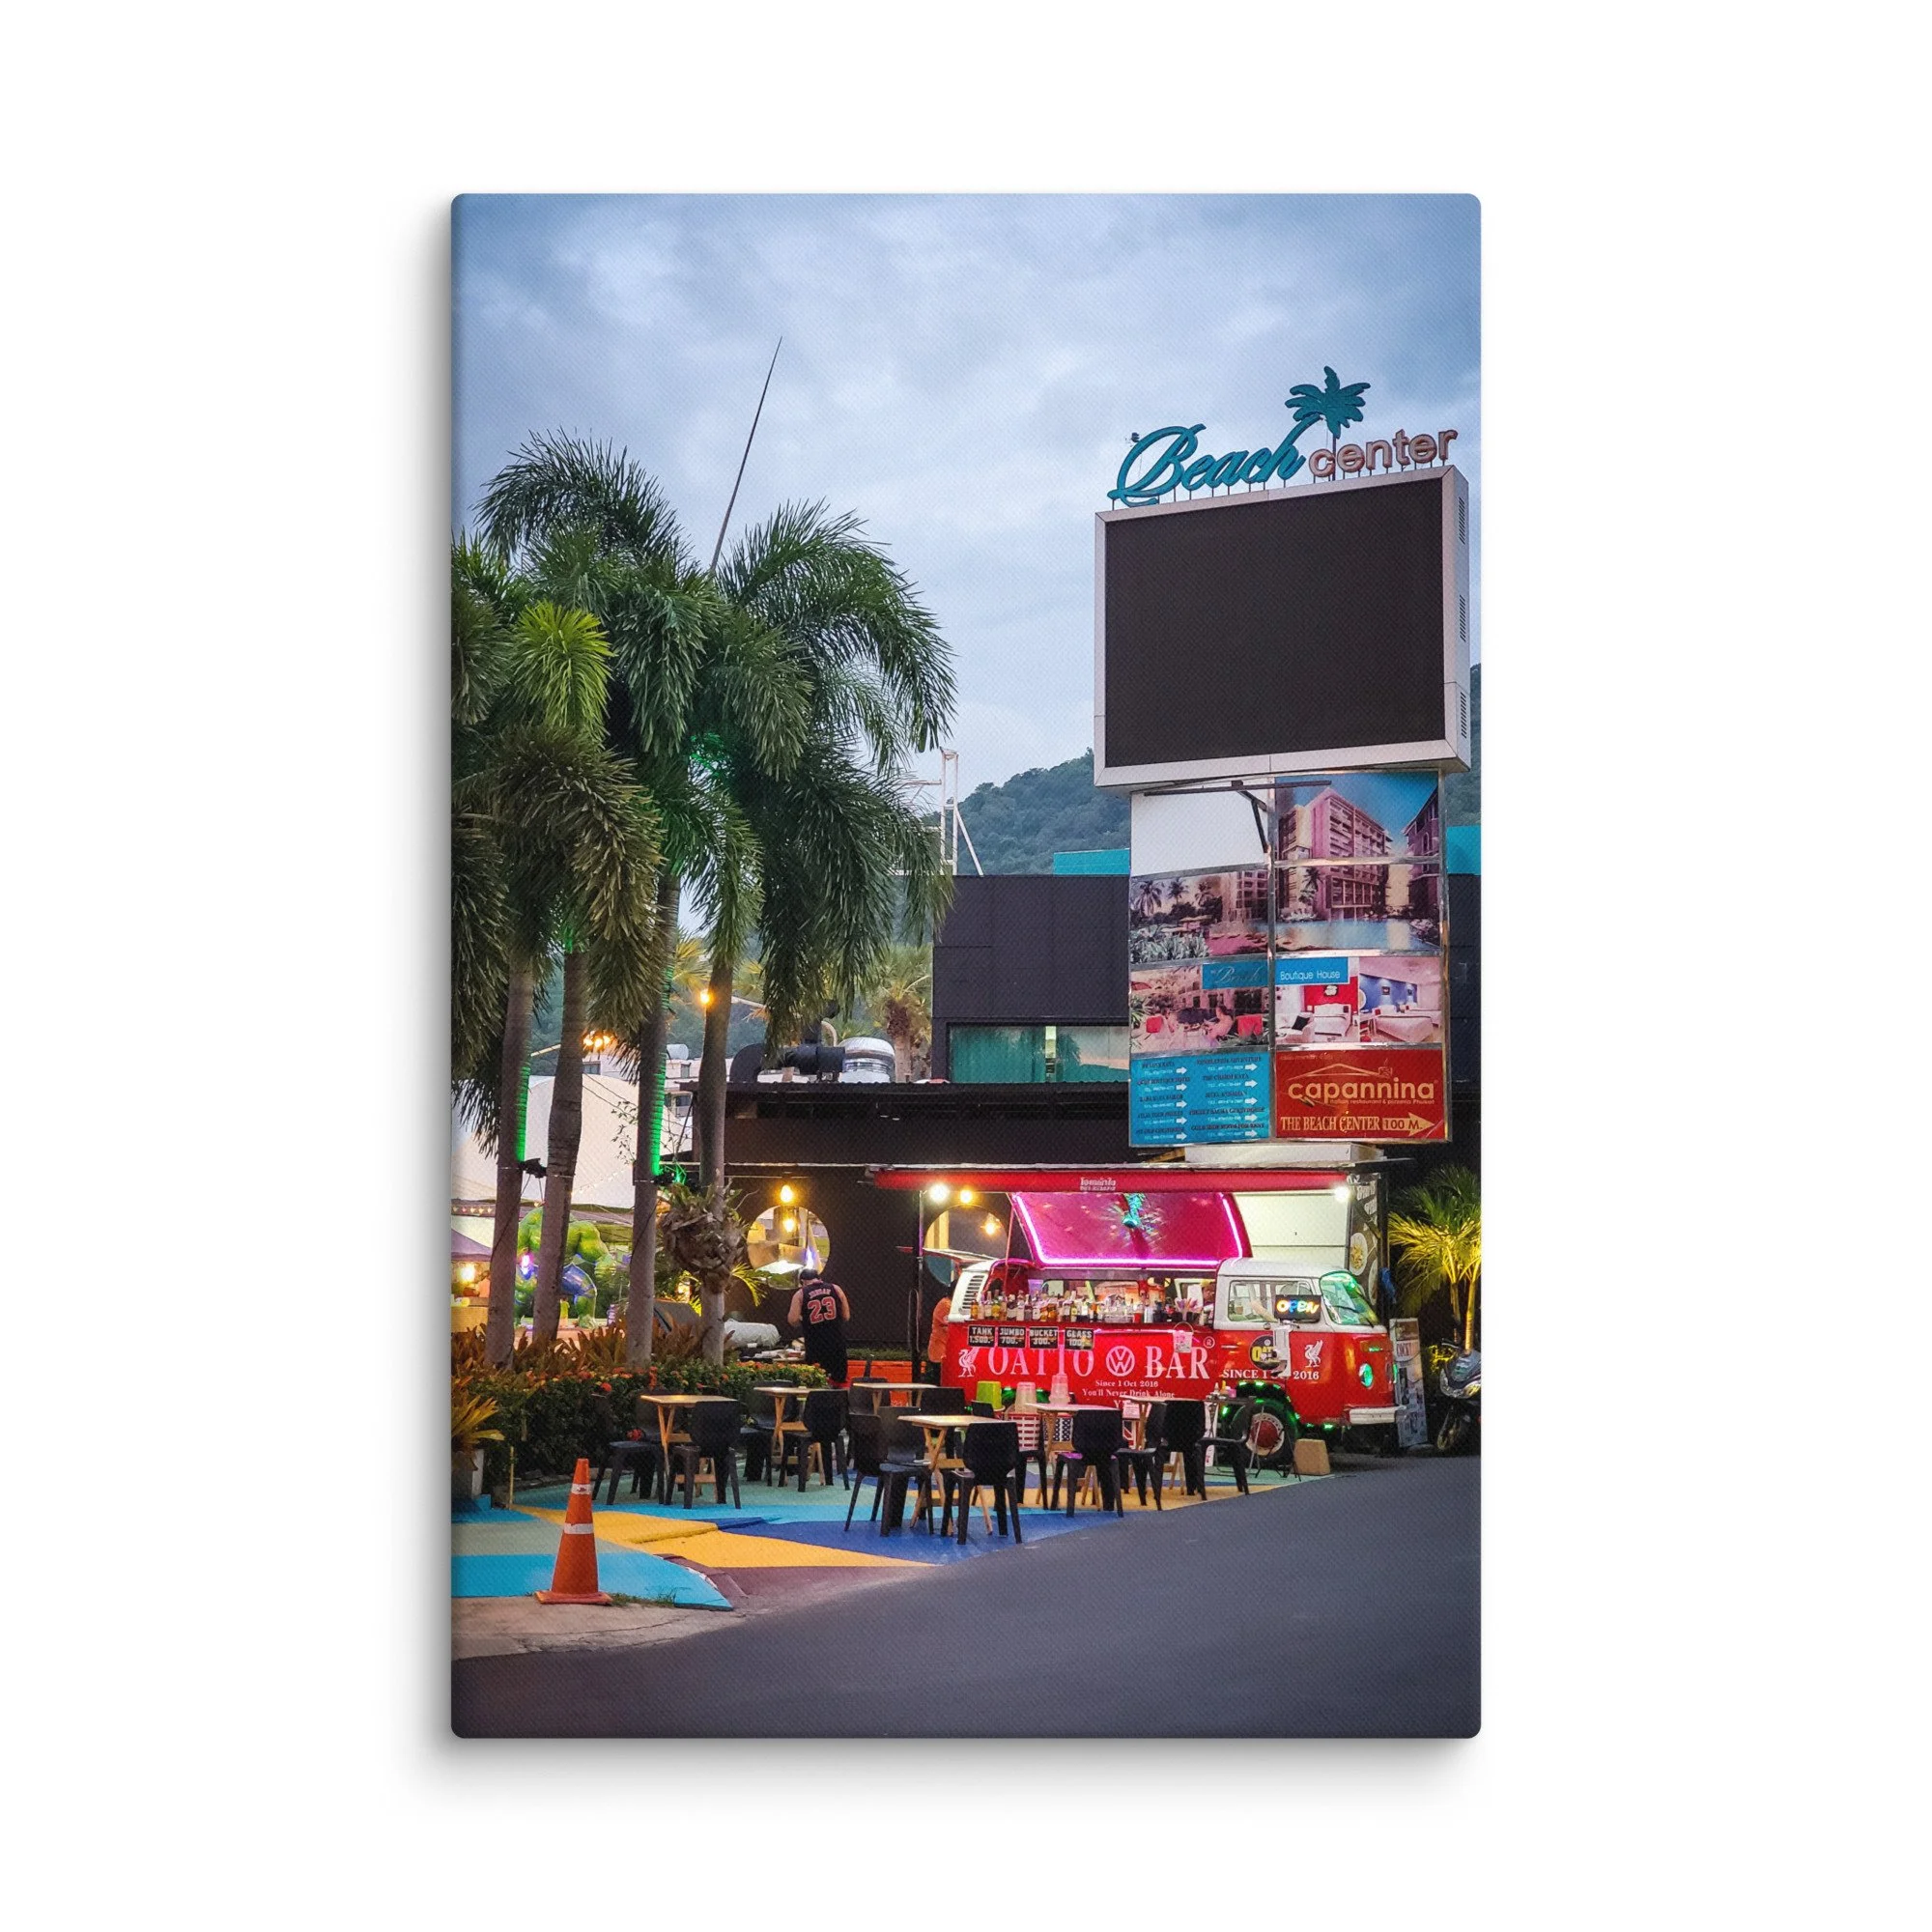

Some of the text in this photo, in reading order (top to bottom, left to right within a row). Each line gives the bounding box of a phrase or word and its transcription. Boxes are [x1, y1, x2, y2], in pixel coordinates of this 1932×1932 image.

[1107, 411, 1459, 508] Beach center
[1280, 971, 1341, 980] Boutique House
[1288, 1076, 1435, 1104] capannina
[1281, 1116, 1301, 1131] THE
[1304, 1116, 1337, 1131] BEACH
[1339, 1116, 1380, 1132] CENTER
[1384, 1119, 1405, 1130] 100
[1408, 1120, 1423, 1130] M.
[808, 1296, 837, 1323] 23
[1276, 1299, 1321, 1314] OPEN
[972, 1326, 993, 1336] TANK
[999, 1327, 1025, 1337] JUMBO
[1066, 1329, 1093, 1339] GLASS
[1145, 1346, 1210, 1379] BAR
[1223, 1369, 1259, 1378] SINCE
[1293, 1371, 1320, 1380] 2016
[1082, 1388, 1104, 1397] You'll
[1106, 1388, 1127, 1398] Never
